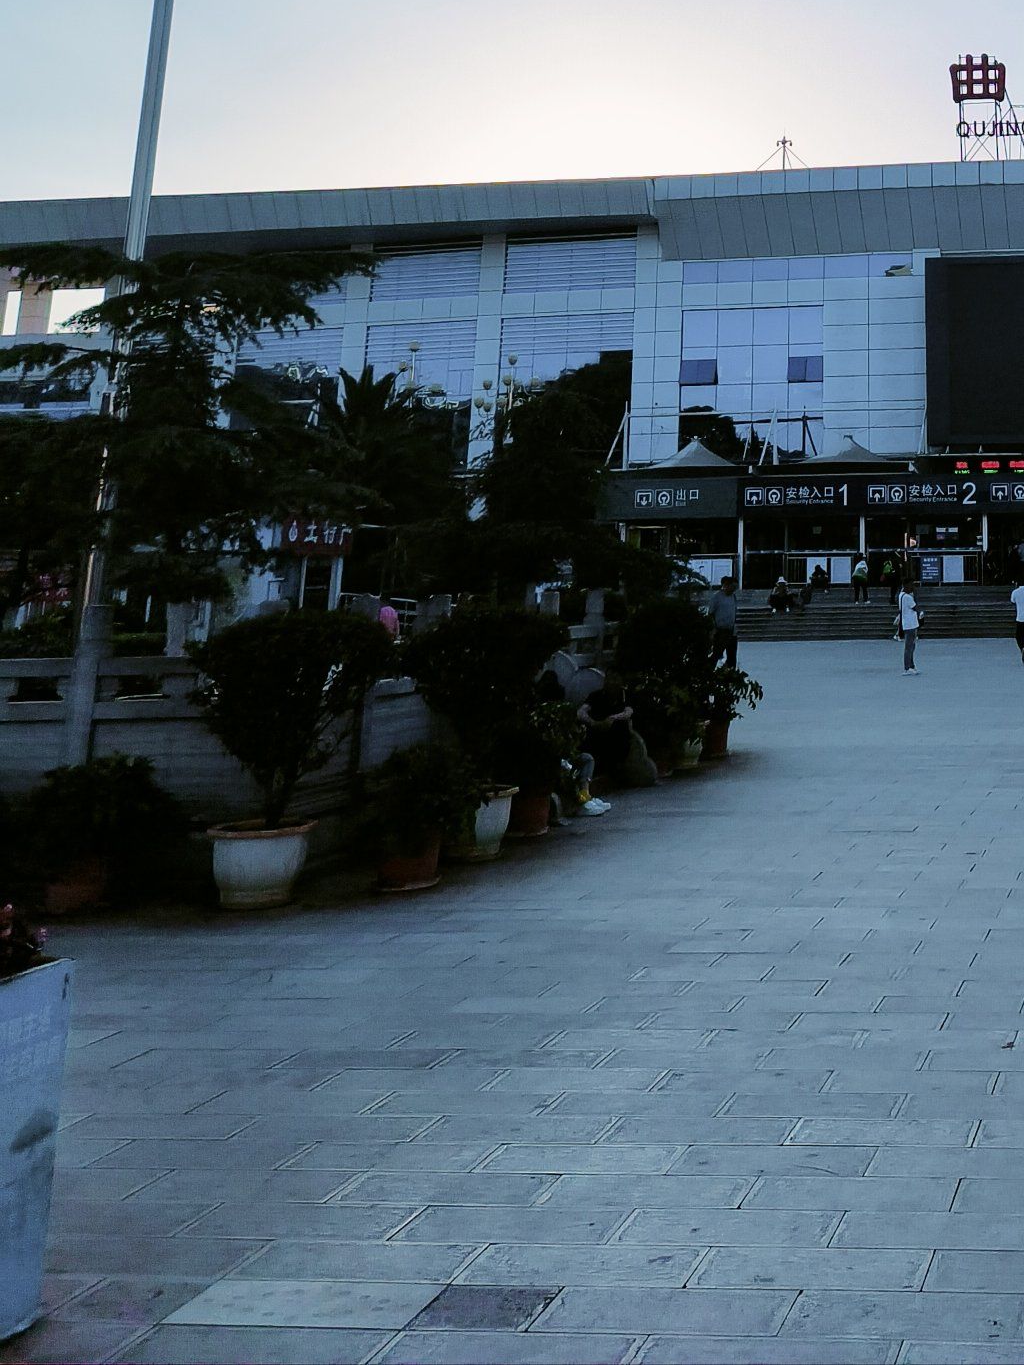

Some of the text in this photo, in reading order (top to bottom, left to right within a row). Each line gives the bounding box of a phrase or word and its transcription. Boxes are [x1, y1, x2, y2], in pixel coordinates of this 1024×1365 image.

[676, 488, 700, 501] 出口
[786, 483, 849, 506] 安检入口 1
[909, 482, 977, 504] 安检入口 2
